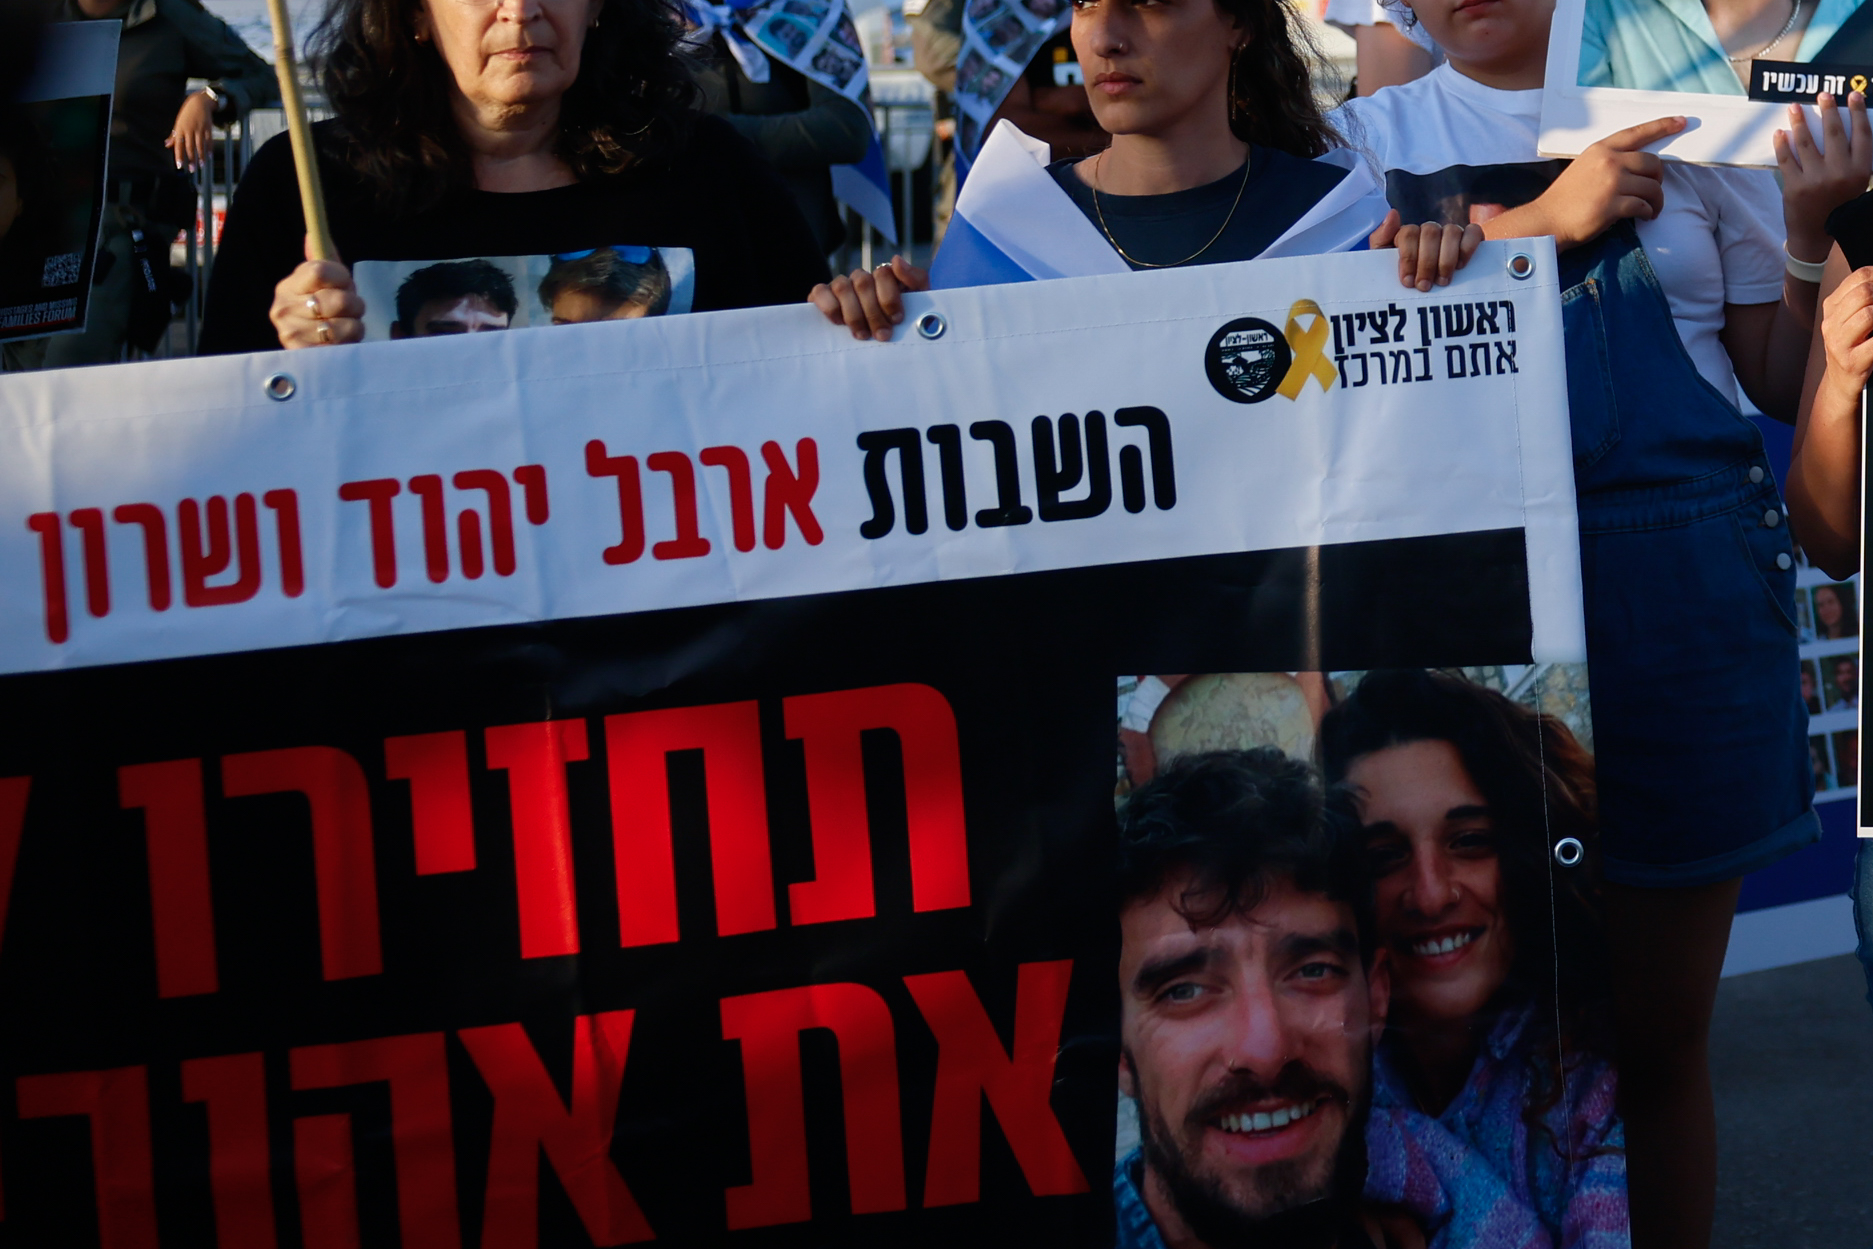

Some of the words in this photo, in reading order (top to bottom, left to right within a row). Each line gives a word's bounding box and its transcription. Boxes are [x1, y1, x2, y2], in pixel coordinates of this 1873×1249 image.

[1762, 71, 1820, 95] עכשיו
[1823, 74, 1846, 96] זה
[1330, 303, 1408, 355] לציון
[1417, 300, 1517, 346] ראשון
[1445, 340, 1519, 379] אתם
[1333, 347, 1434, 389] במרכז
[584, 435, 825, 566] ארבל
[856, 404, 1179, 540] השבות
[27, 487, 305, 645] ושרון
[339, 463, 550, 590] יהוד
[117, 682, 972, 1000] תחזירו
[719, 958, 1091, 1233] את
